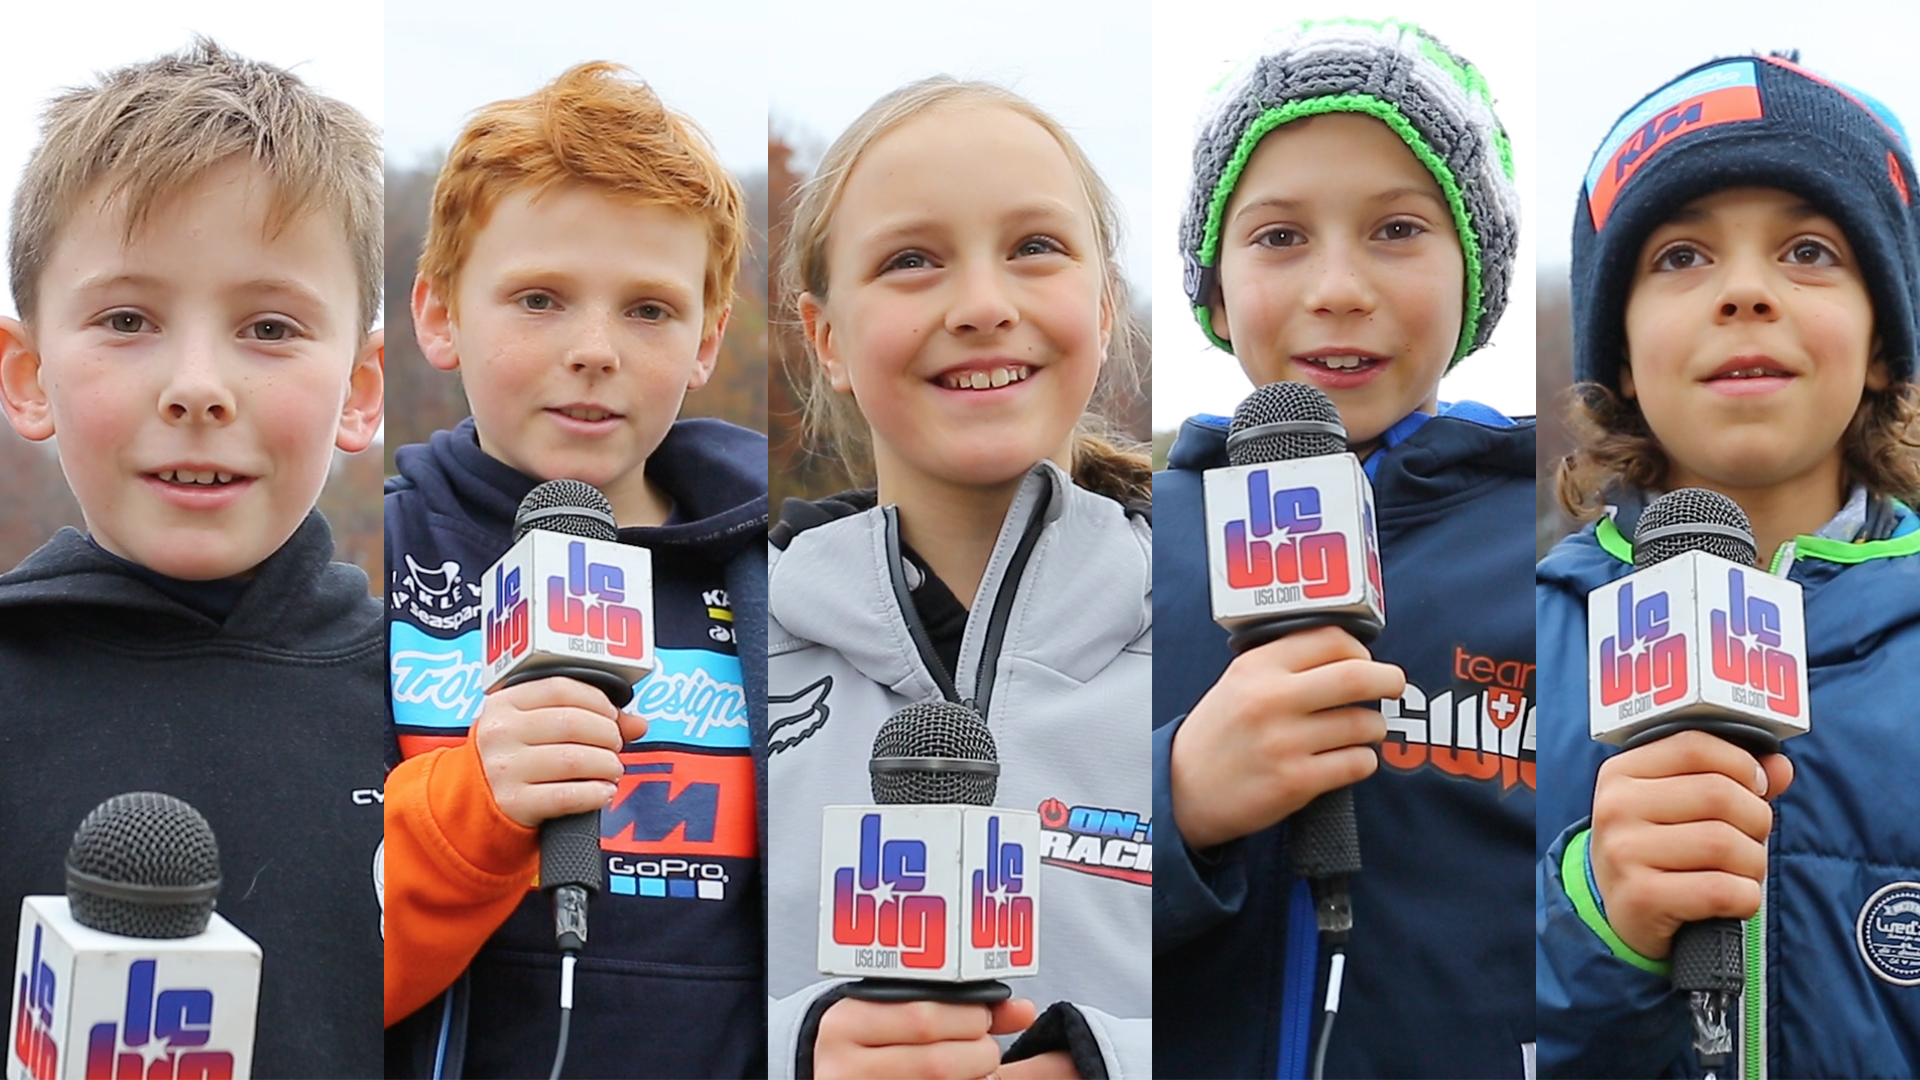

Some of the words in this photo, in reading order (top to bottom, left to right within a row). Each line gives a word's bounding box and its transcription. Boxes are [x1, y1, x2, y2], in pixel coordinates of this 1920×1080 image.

[1613, 101, 1705, 187] KTM
[392, 570, 482, 610] AKLEY
[1254, 585, 1301, 607] usa.com
[568, 637, 606, 656] usa.com
[391, 650, 485, 720] Troy
[626, 660, 750, 738] esign
[1067, 806, 1152, 842] ON-
[608, 856, 726, 879] GoPro
[1040, 830, 1152, 872] RACI
[855, 948, 898, 970] usa.com
